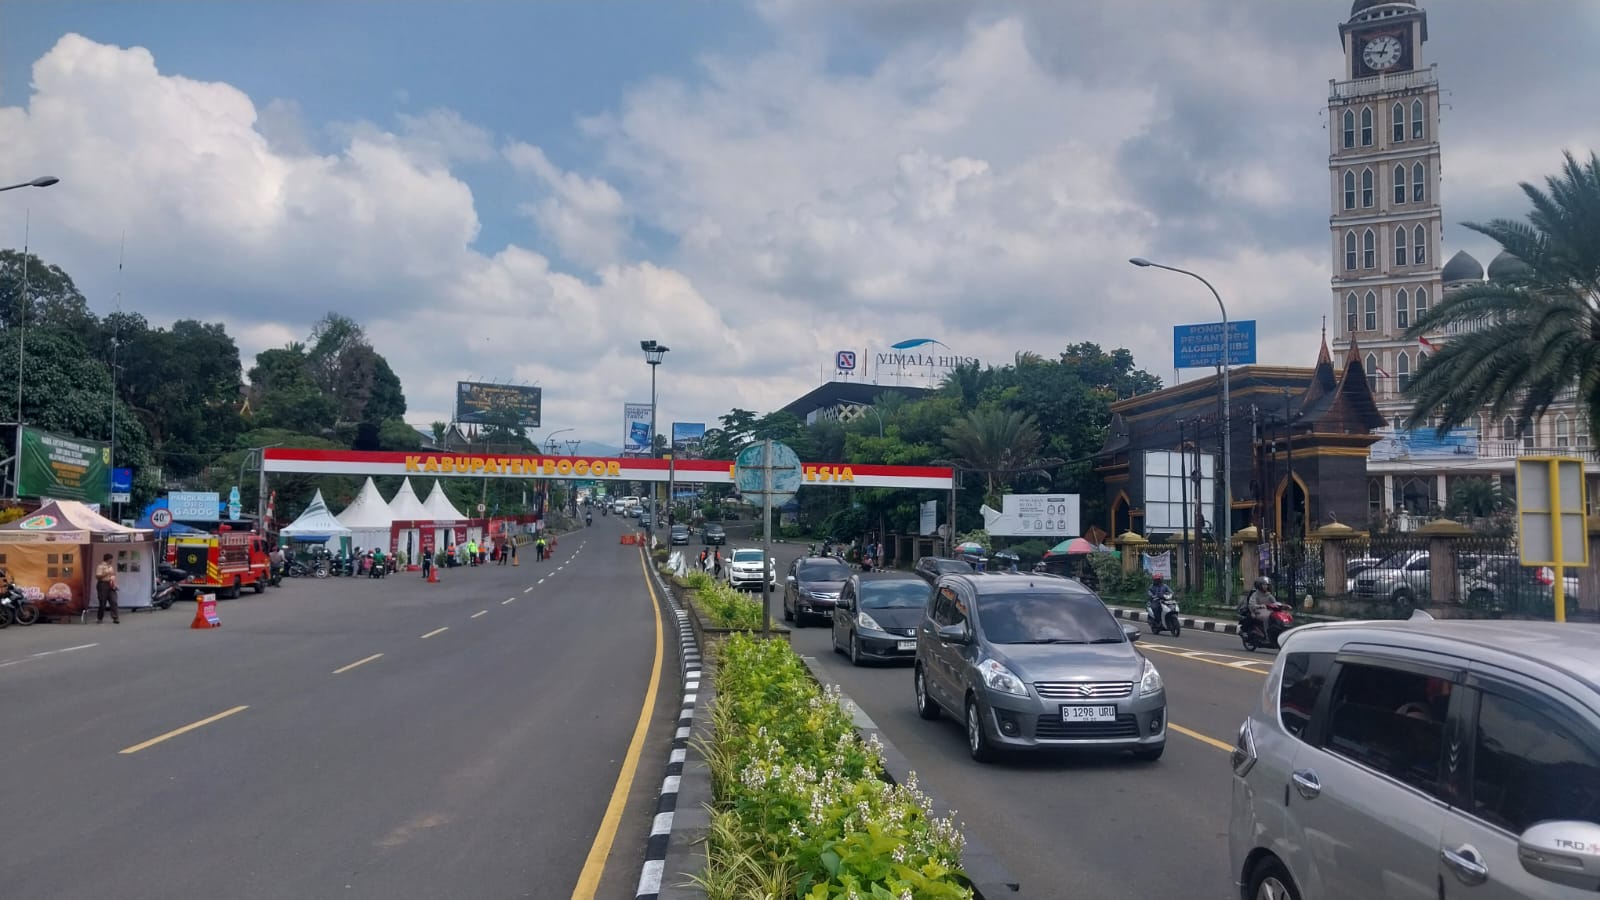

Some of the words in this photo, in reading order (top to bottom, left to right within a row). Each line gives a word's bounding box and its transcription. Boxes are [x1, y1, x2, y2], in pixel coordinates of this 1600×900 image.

[405, 455, 538, 475] KABUPATEN
[542, 459, 621, 476] BOGOR
[153, 512, 164, 522] 40
[1064, 707, 1069, 717] B
[1073, 707, 1094, 717] 1298
[1099, 707, 1115, 717] URU
[1554, 838, 1585, 851] TRD
